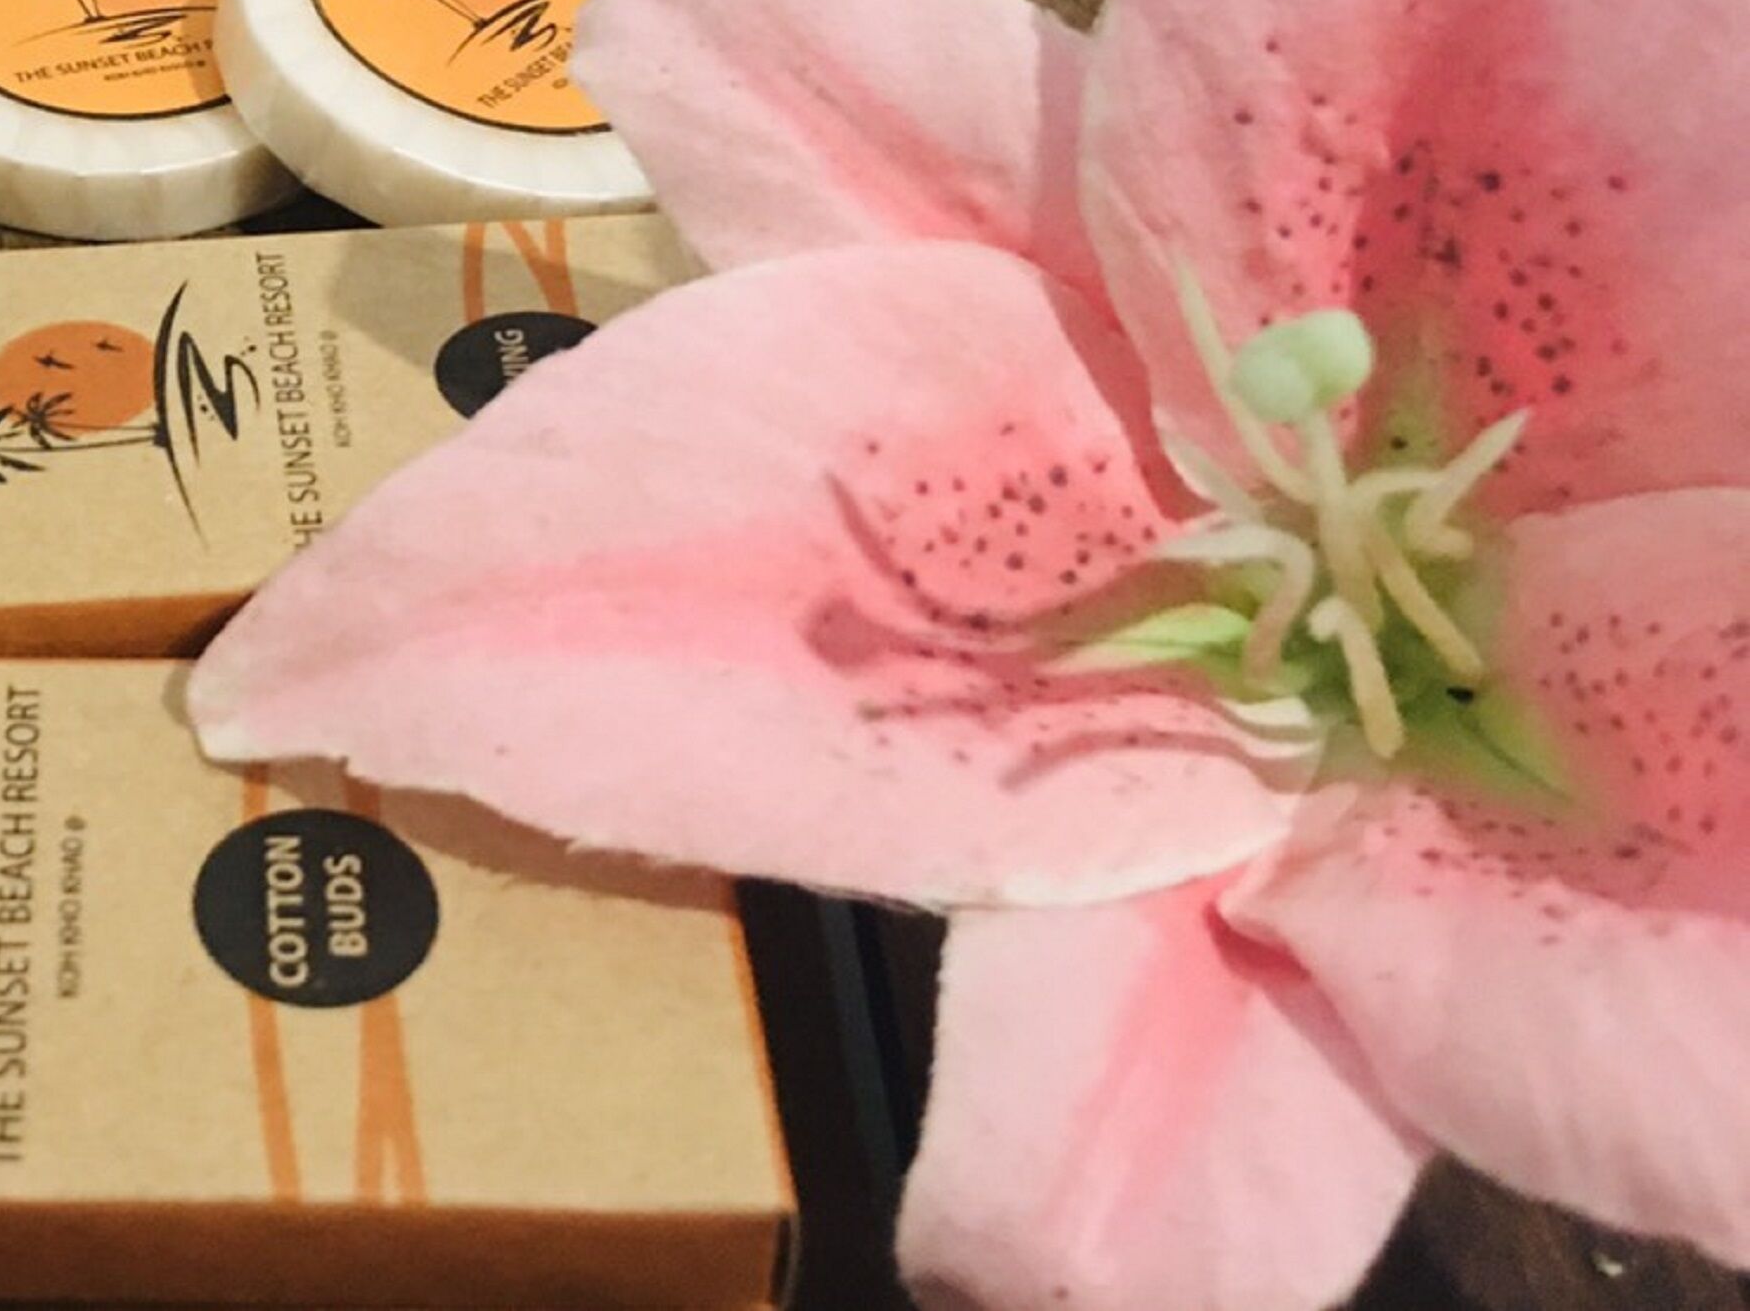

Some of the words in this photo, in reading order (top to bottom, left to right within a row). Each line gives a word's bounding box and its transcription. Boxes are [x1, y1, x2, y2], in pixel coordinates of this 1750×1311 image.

[15, 69, 52, 83] THE
[55, 53, 130, 76] SUNSET
[136, 42, 200, 63] BEACH
[477, 85, 512, 108] THE
[503, 55, 556, 93] SUNSET
[255, 251, 293, 329] RESORT
[266, 331, 306, 404] BEACH
[276, 406, 320, 504] SUNSET
[290, 511, 322, 552] HE
[1, 684, 42, 802] RESORT
[265, 834, 309, 987] COTTON
[324, 853, 369, 958] BUDS
